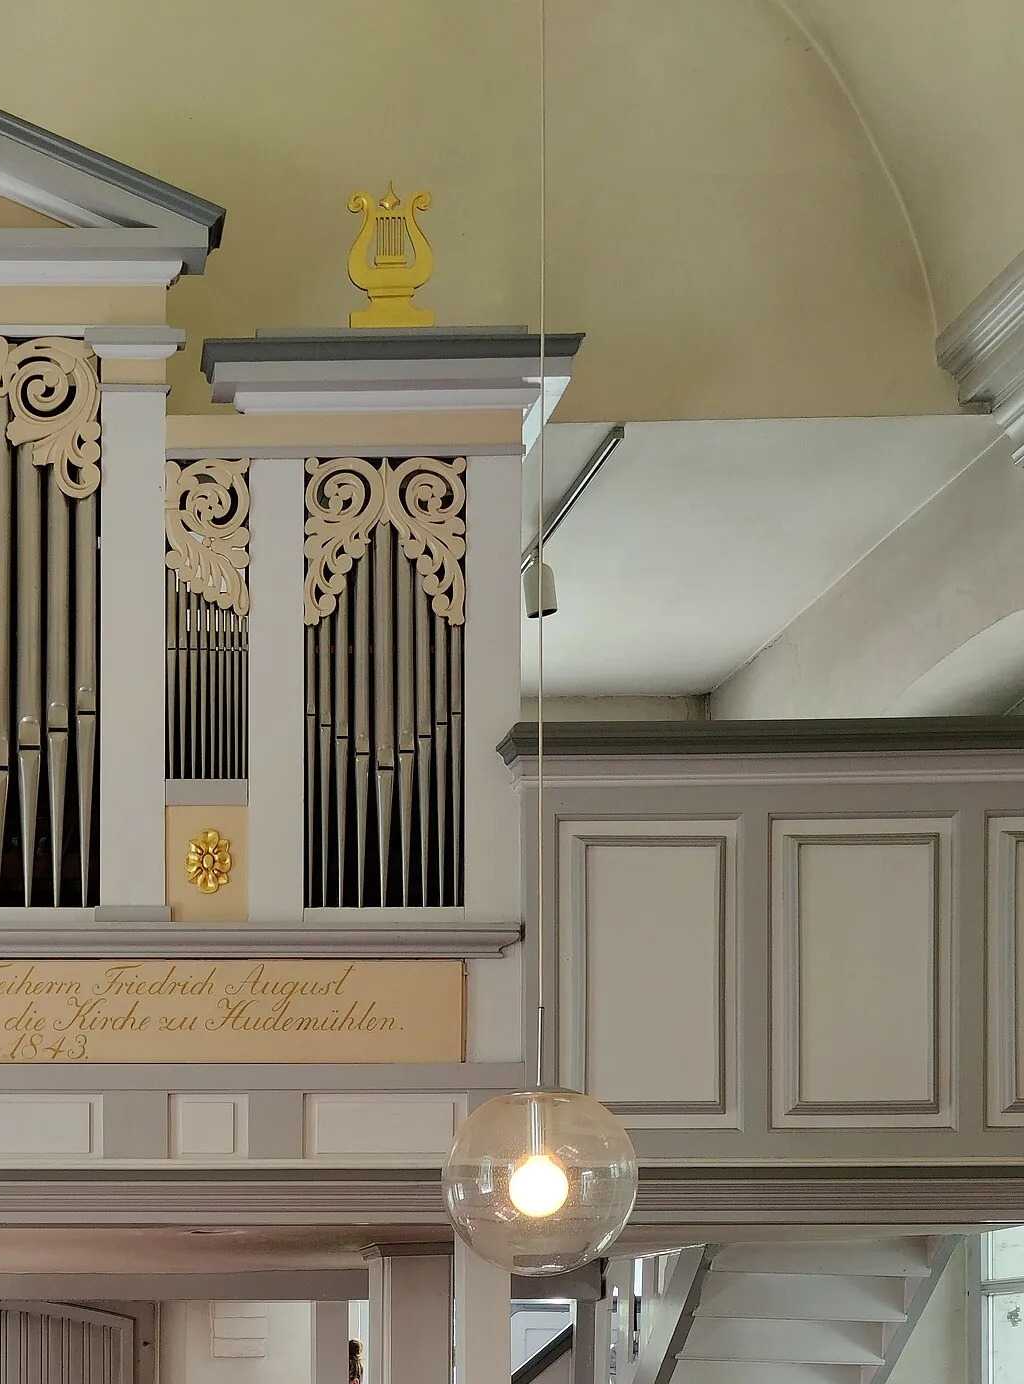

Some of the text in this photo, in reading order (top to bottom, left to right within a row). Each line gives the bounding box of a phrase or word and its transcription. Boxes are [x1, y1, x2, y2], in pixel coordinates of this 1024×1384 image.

[92, 962, 217, 996] Friedrich
[224, 963, 356, 1012] August
[4, 1000, 46, 1031] die
[52, 996, 151, 1031] Kirche
[159, 1015, 196, 1031] zu
[204, 997, 405, 1032] Hudemühlen.
[9, 1032, 89, 1060] 1843.
